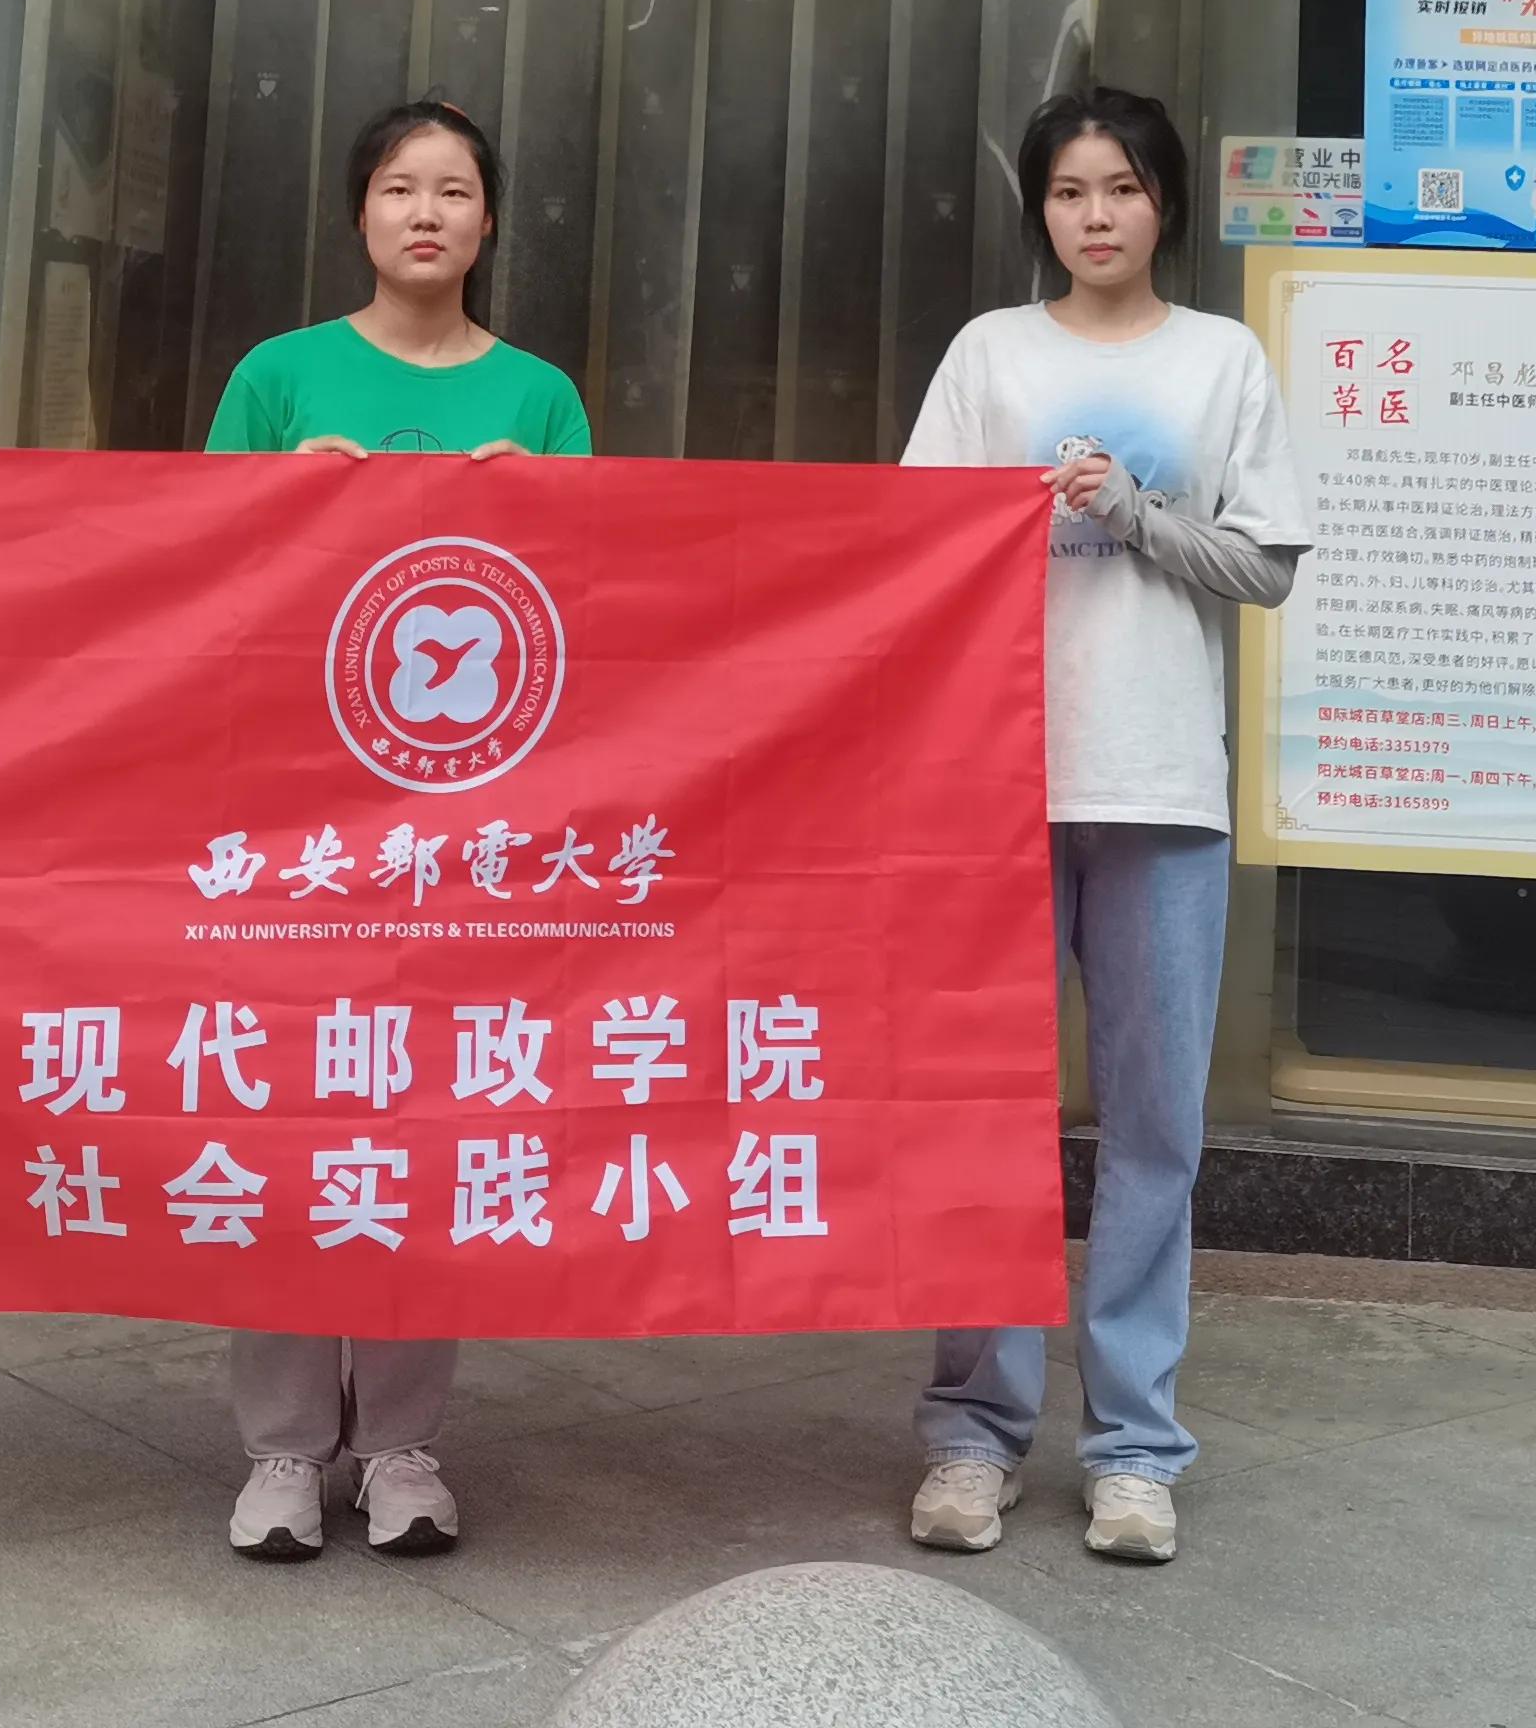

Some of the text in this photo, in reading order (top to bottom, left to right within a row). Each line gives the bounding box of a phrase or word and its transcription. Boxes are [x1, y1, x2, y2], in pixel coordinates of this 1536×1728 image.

[1417, 0, 1488, 16] 实时报销
[1284, 148, 1361, 169] 营业中
[1282, 171, 1362, 189] 欢迎光临
[344, 587, 390, 682] UNIVERSITY
[386, 574, 407, 595] OF
[409, 556, 460, 580] POSTS
[479, 562, 549, 733] TELECOMMUNICATIONS
[241, 922, 353, 940] UNIVERSITY
[356, 922, 383, 940] OF
[384, 922, 445, 940] POSTS
[447, 922, 463, 940] &
[465, 921, 676, 941] TELECOMMUNICATIONS
[17, 994, 826, 1117] 现代邮政学院
[23, 1130, 830, 1253] 社会实践小组
